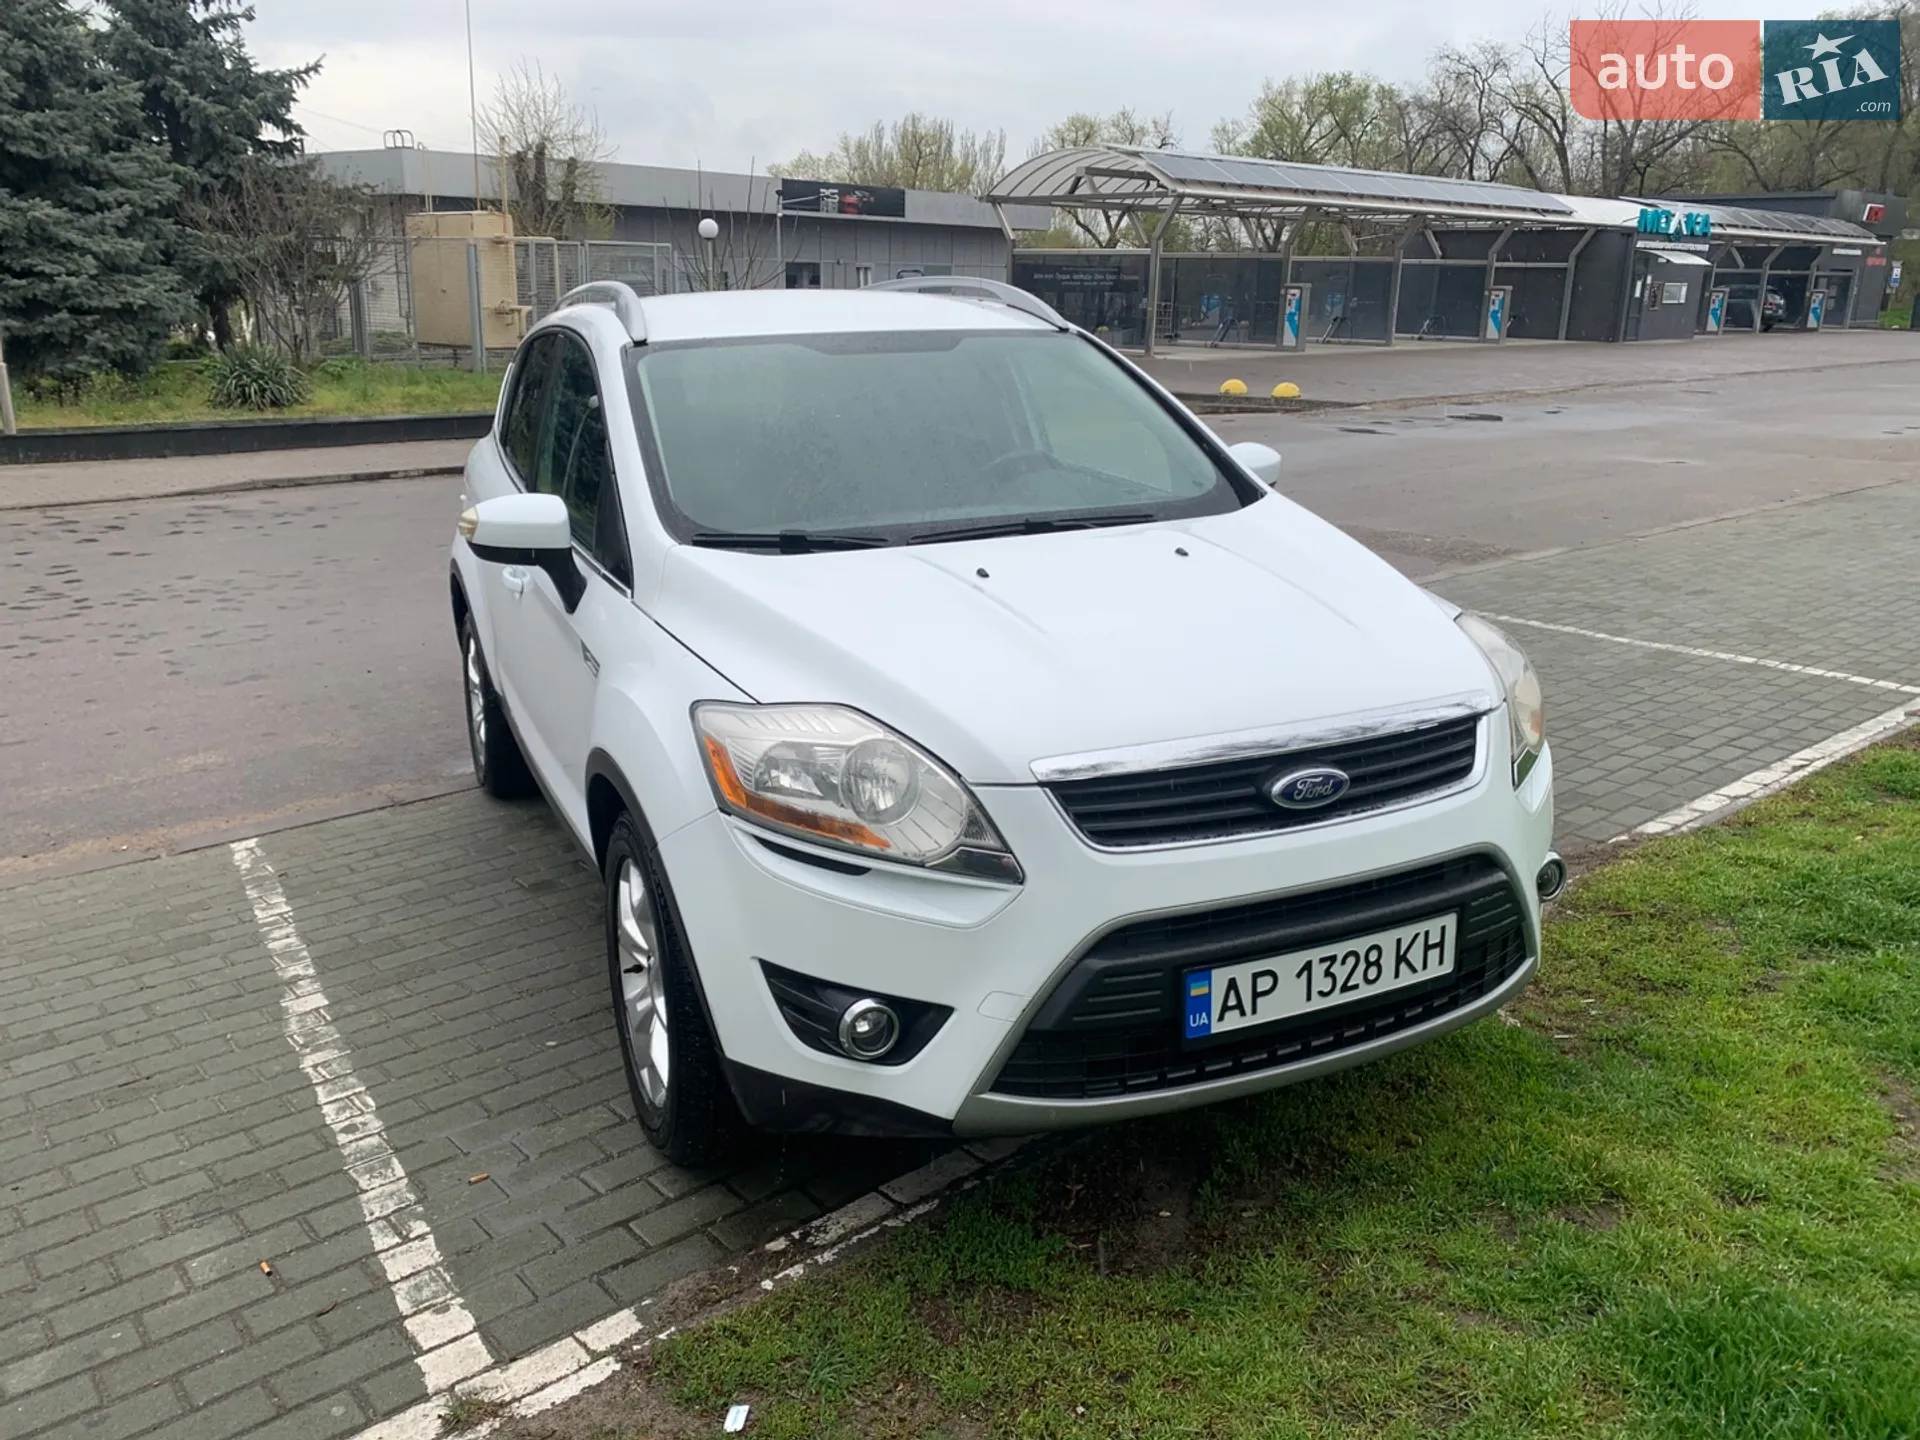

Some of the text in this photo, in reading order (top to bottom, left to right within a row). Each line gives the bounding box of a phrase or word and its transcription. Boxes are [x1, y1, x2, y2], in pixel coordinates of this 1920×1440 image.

[1294, 776, 1335, 801] Ford
[1216, 925, 1447, 1024] AP 1328 KH
[1189, 1012, 1210, 1028] UA
